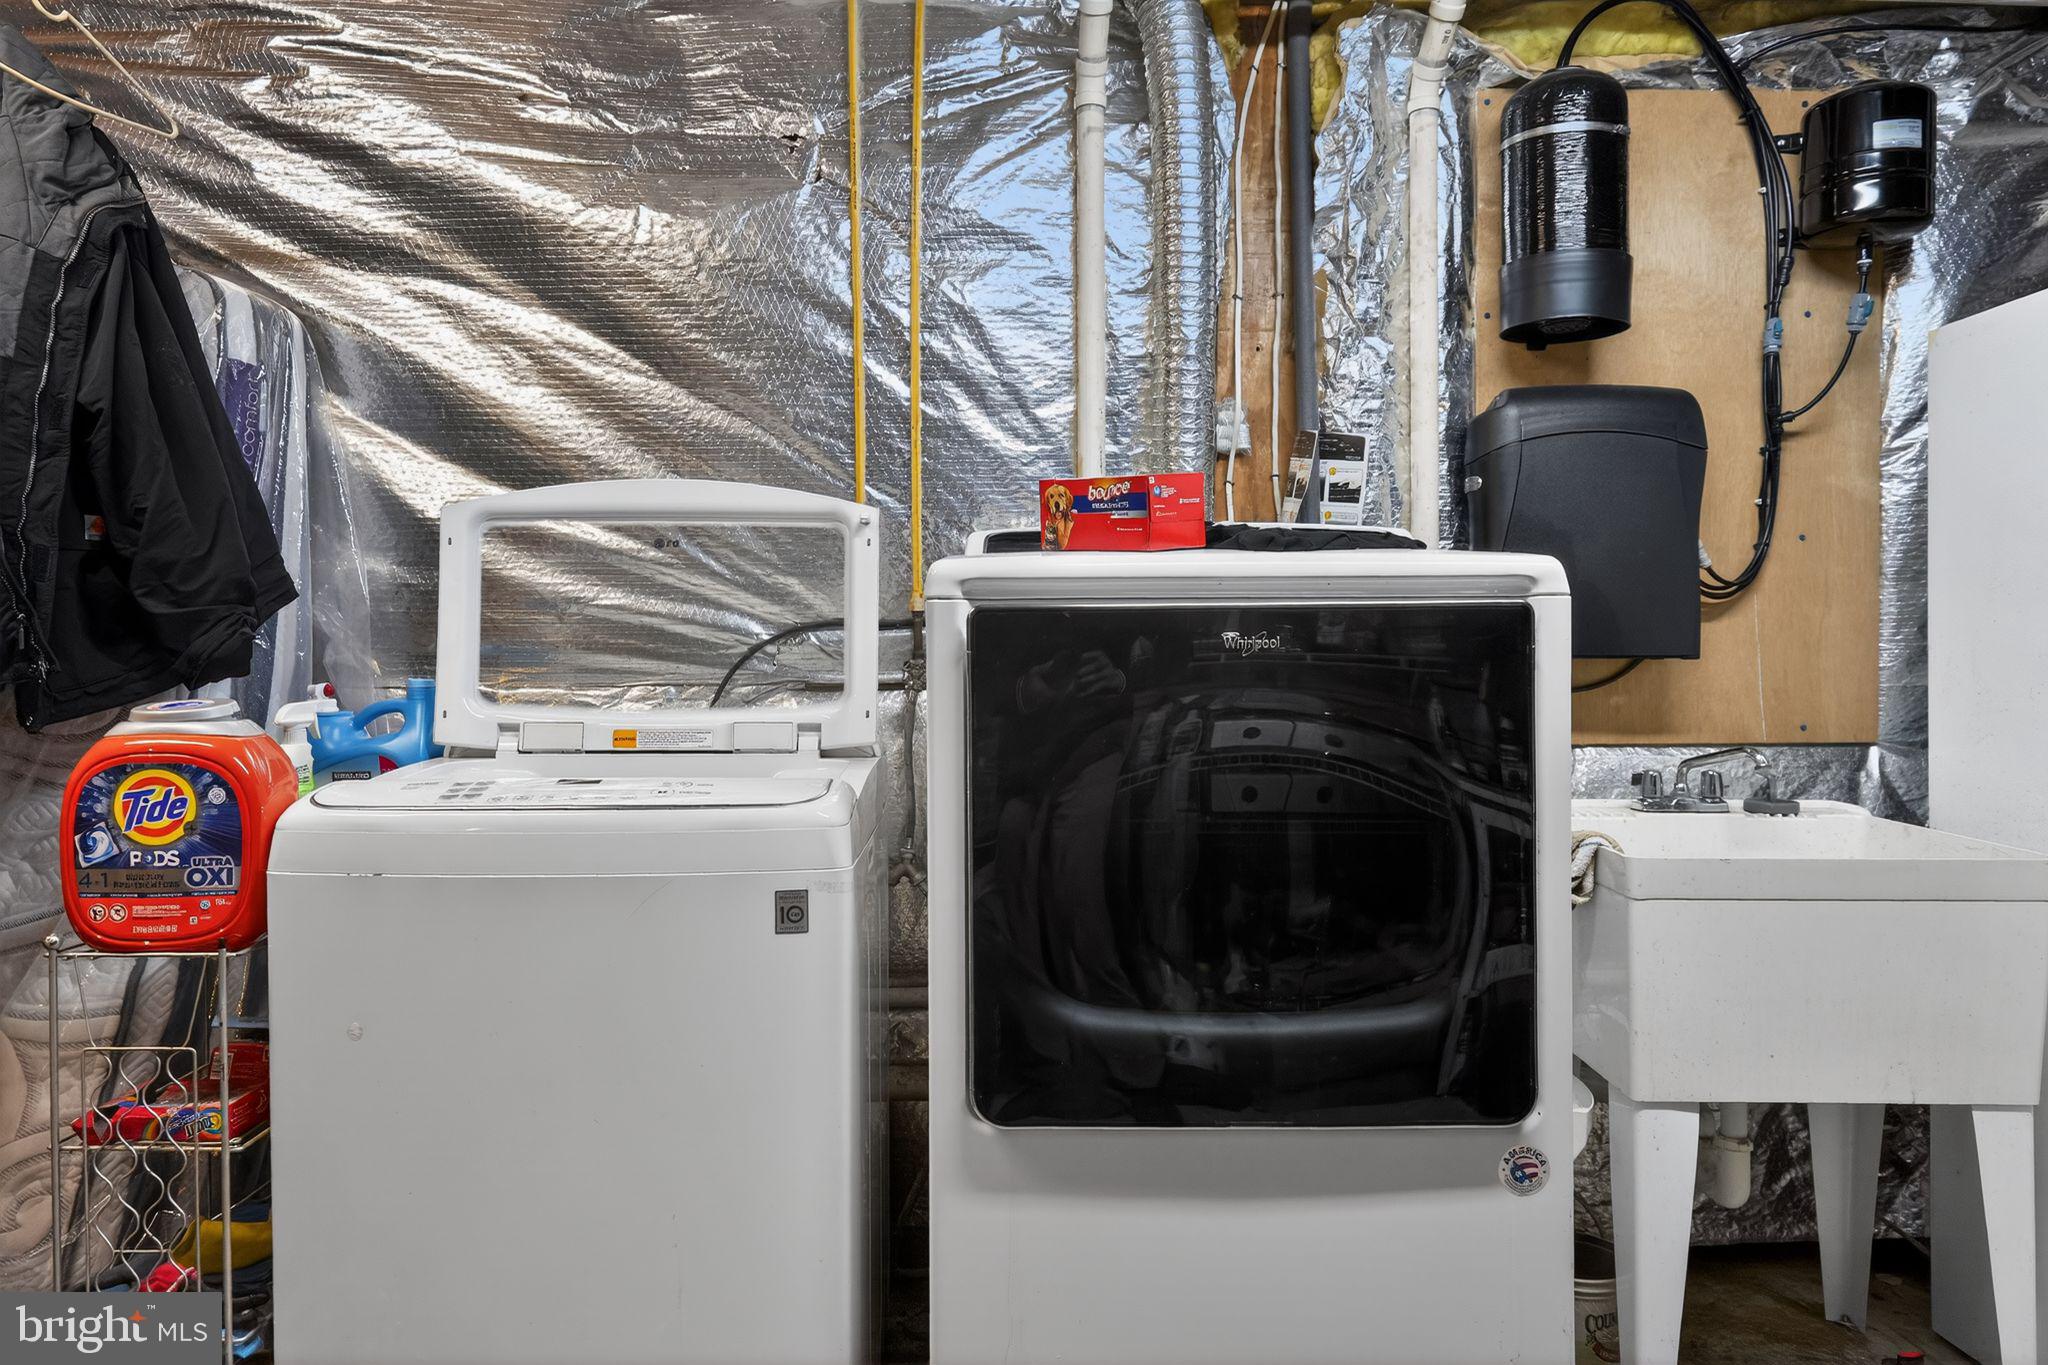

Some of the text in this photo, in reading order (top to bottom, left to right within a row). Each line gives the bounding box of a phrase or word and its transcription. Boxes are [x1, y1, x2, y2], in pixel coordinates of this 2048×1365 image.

[1221, 631, 1280, 657] Whirlpool
[122, 786, 189, 834] Tide
[192, 857, 233, 867] ULTRA
[186, 868, 233, 887] OXI
